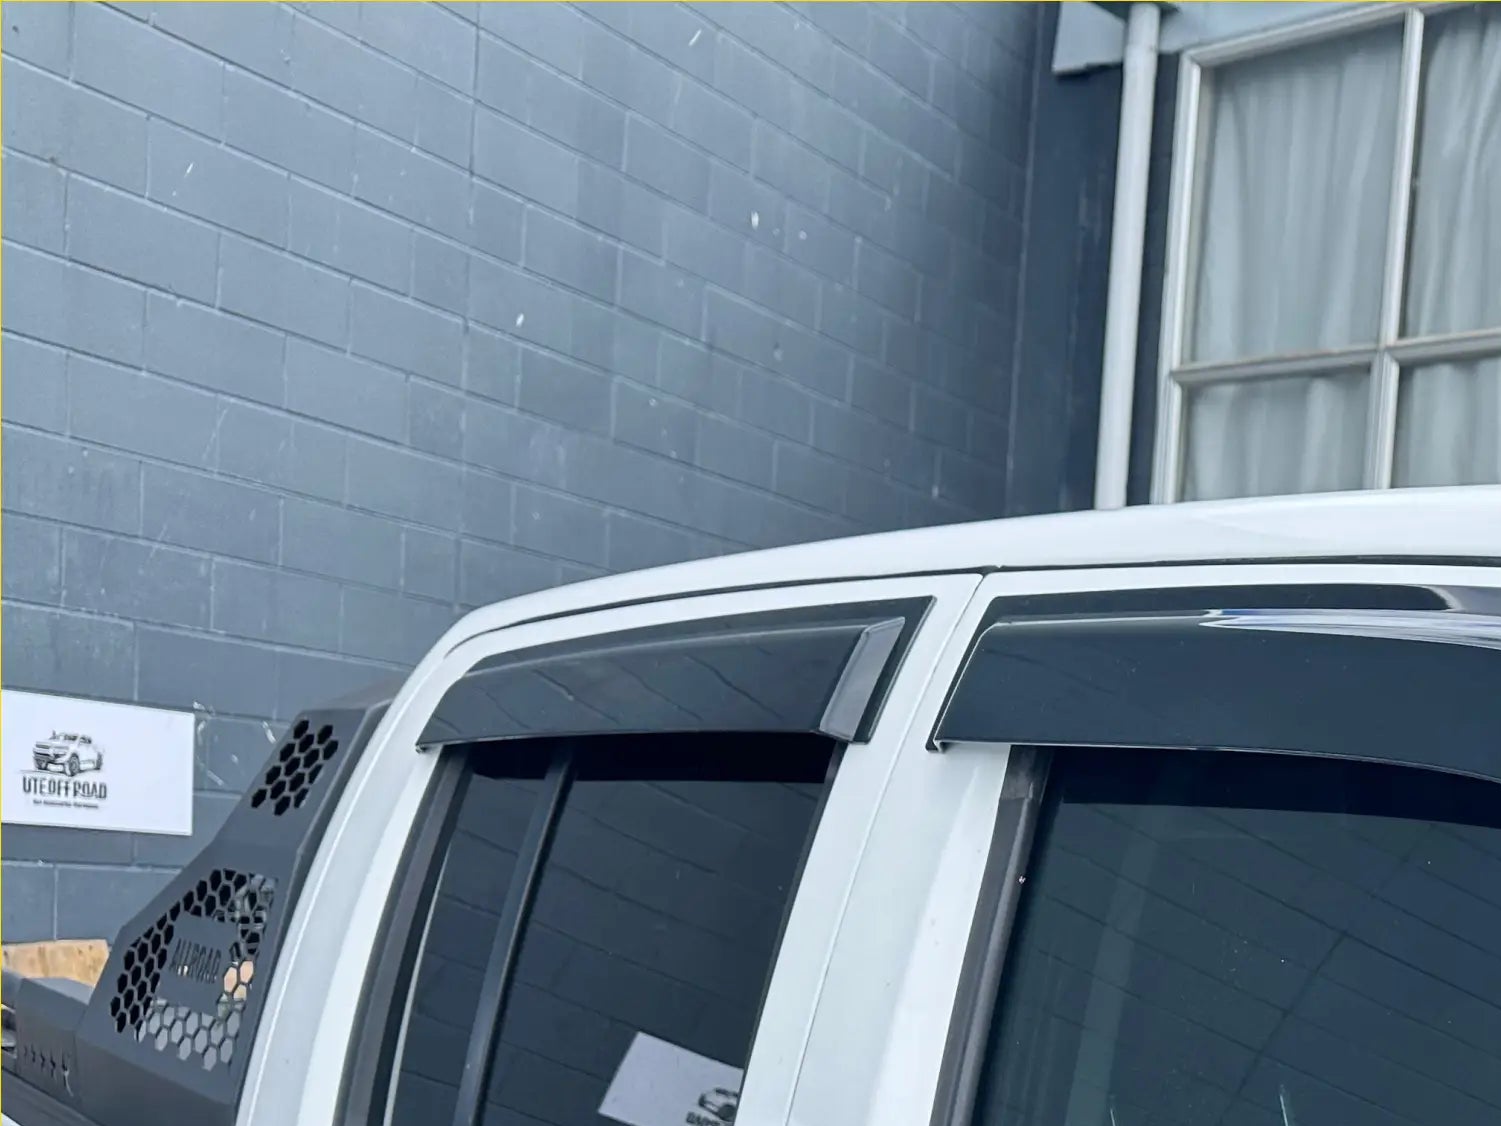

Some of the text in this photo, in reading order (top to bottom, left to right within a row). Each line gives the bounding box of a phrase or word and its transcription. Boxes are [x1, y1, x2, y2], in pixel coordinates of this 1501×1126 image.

[22, 776, 107, 799] UTE OFF ROAD
